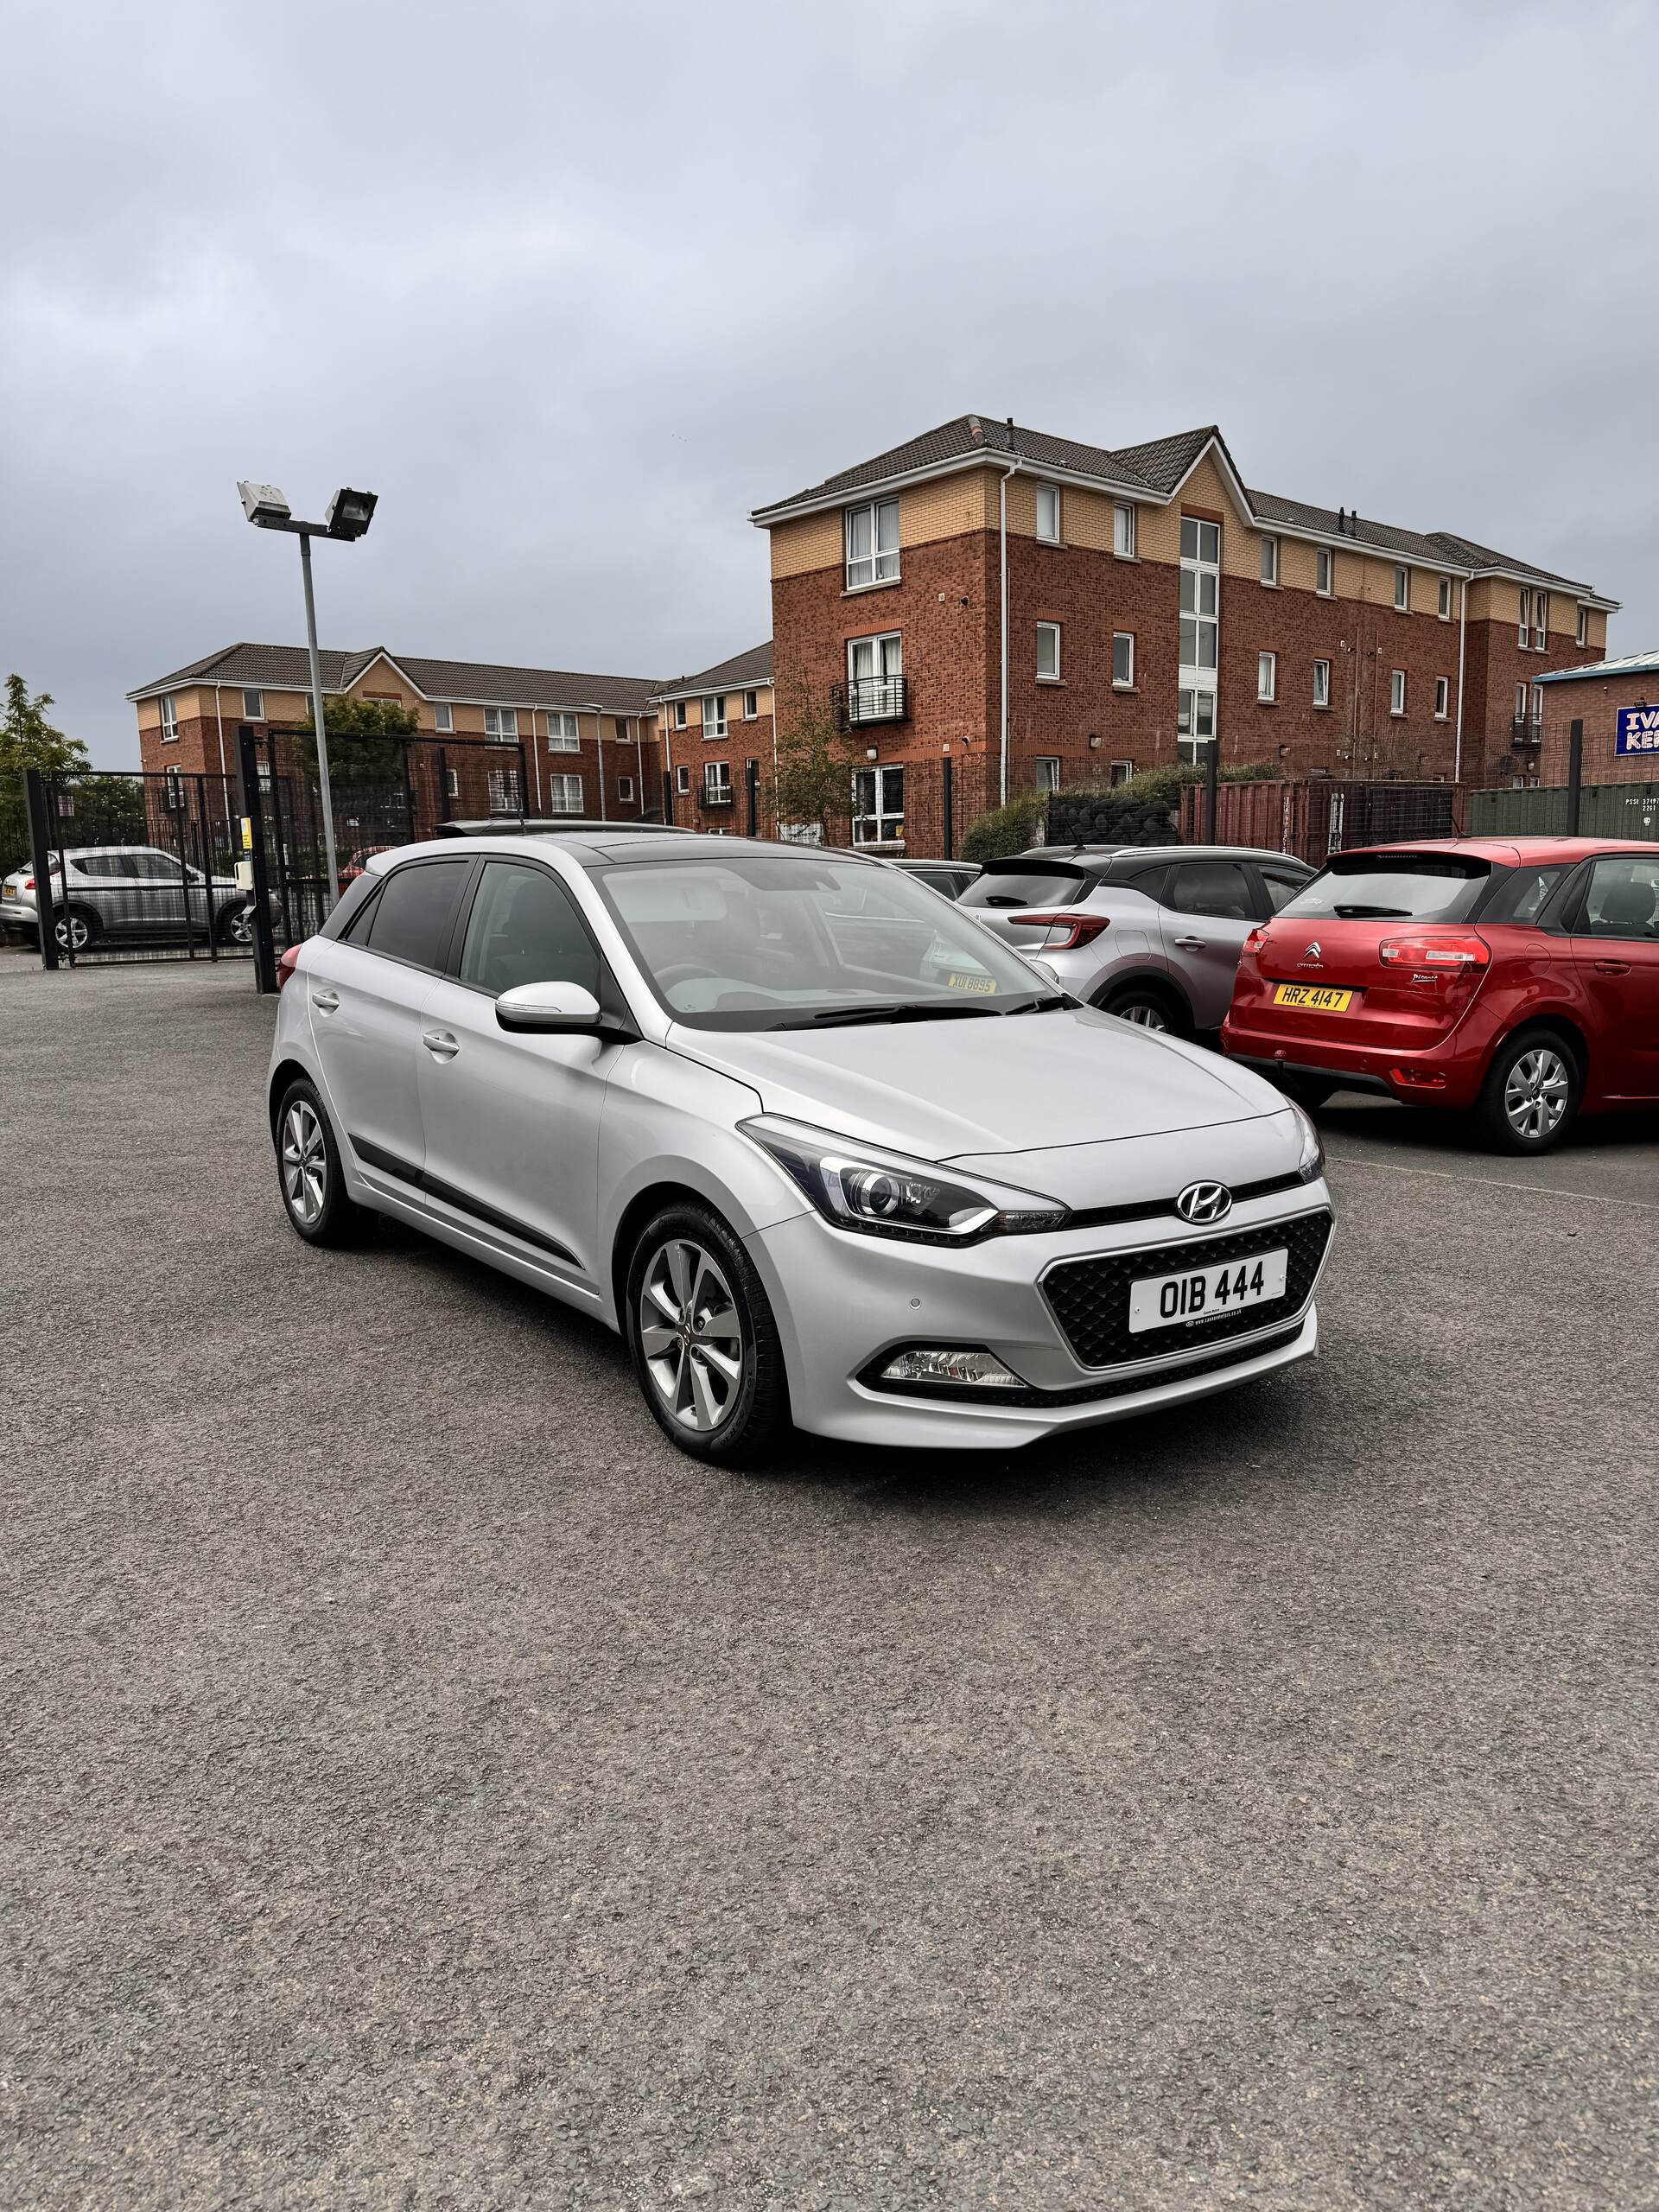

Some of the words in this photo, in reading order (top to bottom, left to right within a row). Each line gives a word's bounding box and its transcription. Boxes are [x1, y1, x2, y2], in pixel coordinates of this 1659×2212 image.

[953, 974, 968, 988] XUI
[968, 977, 992, 992] 8895
[1281, 987, 1310, 1004] HRZ
[1311, 990, 1344, 1007] 4147
[1160, 1275, 1206, 1319] OIB
[1215, 1262, 1264, 1306] 444
